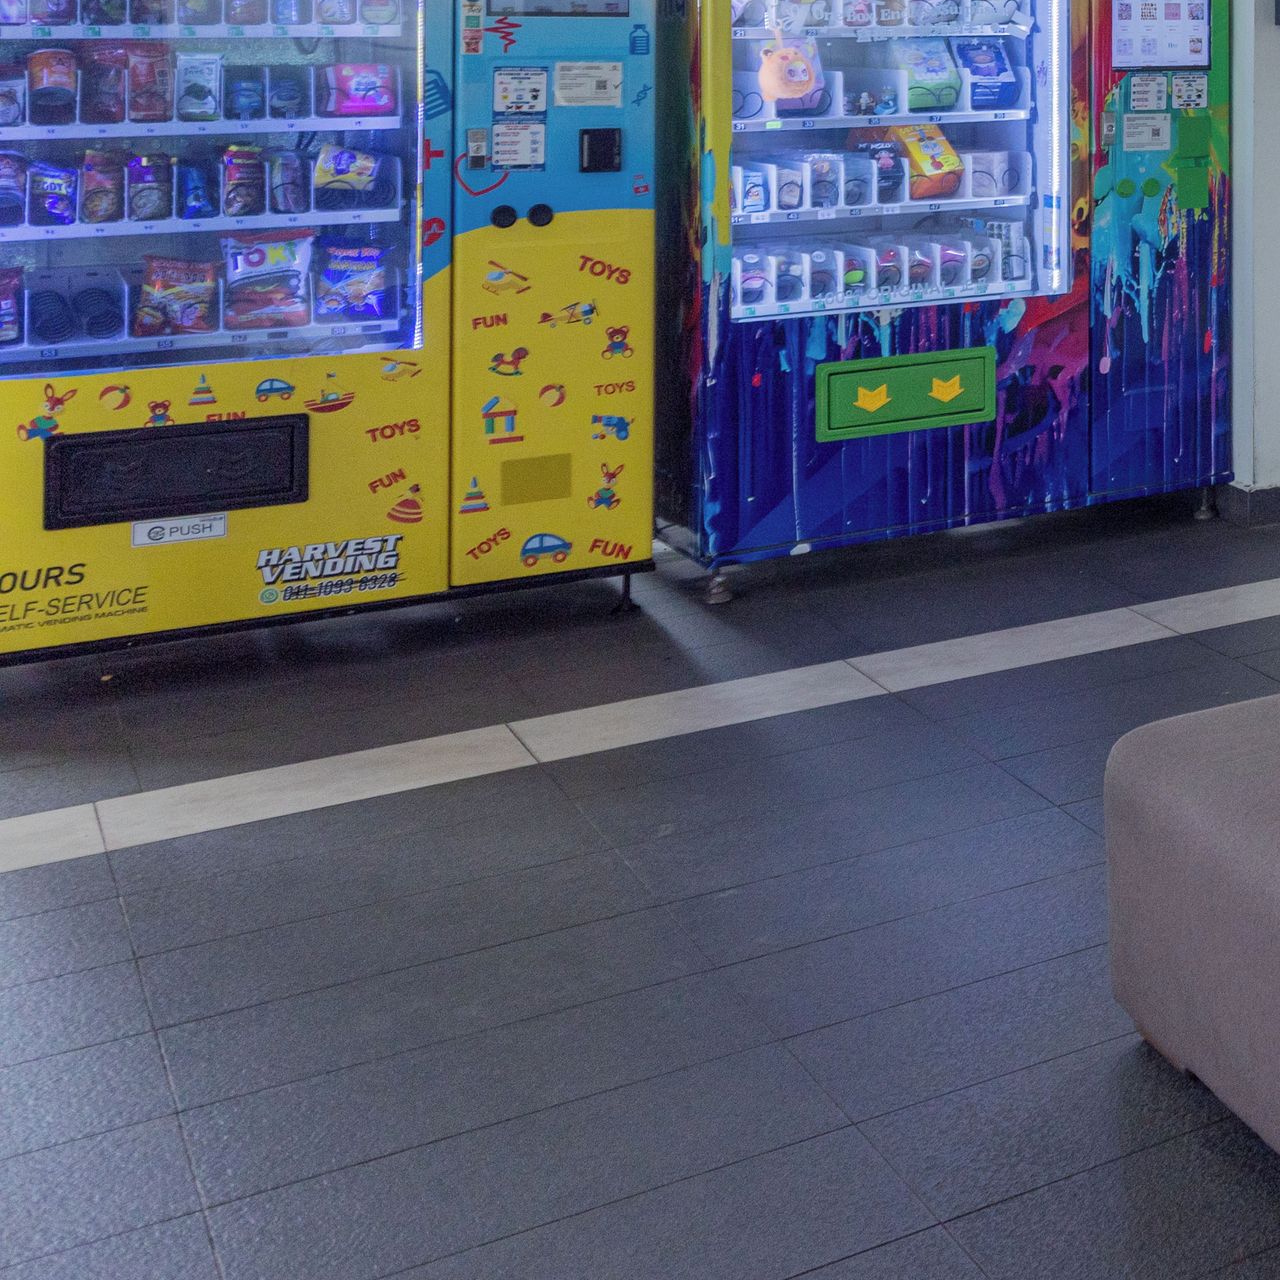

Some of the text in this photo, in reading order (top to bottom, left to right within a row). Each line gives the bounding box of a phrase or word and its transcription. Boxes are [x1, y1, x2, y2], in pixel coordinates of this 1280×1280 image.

[578, 254, 631, 285] TOYS
[471, 313, 509, 330] FUN
[594, 380, 636, 397] TOYS
[365, 418, 421, 444] TOYS
[368, 468, 407, 494] FUN
[169, 521, 213, 538] PUSH
[257, 533, 404, 570] HARVEST
[465, 527, 511, 561] TOYS
[588, 538, 632, 561] FUN
[261, 551, 400, 585] VENDING
[38, 614, 92, 627] VENDING
[94, 606, 148, 619] MACHINE
